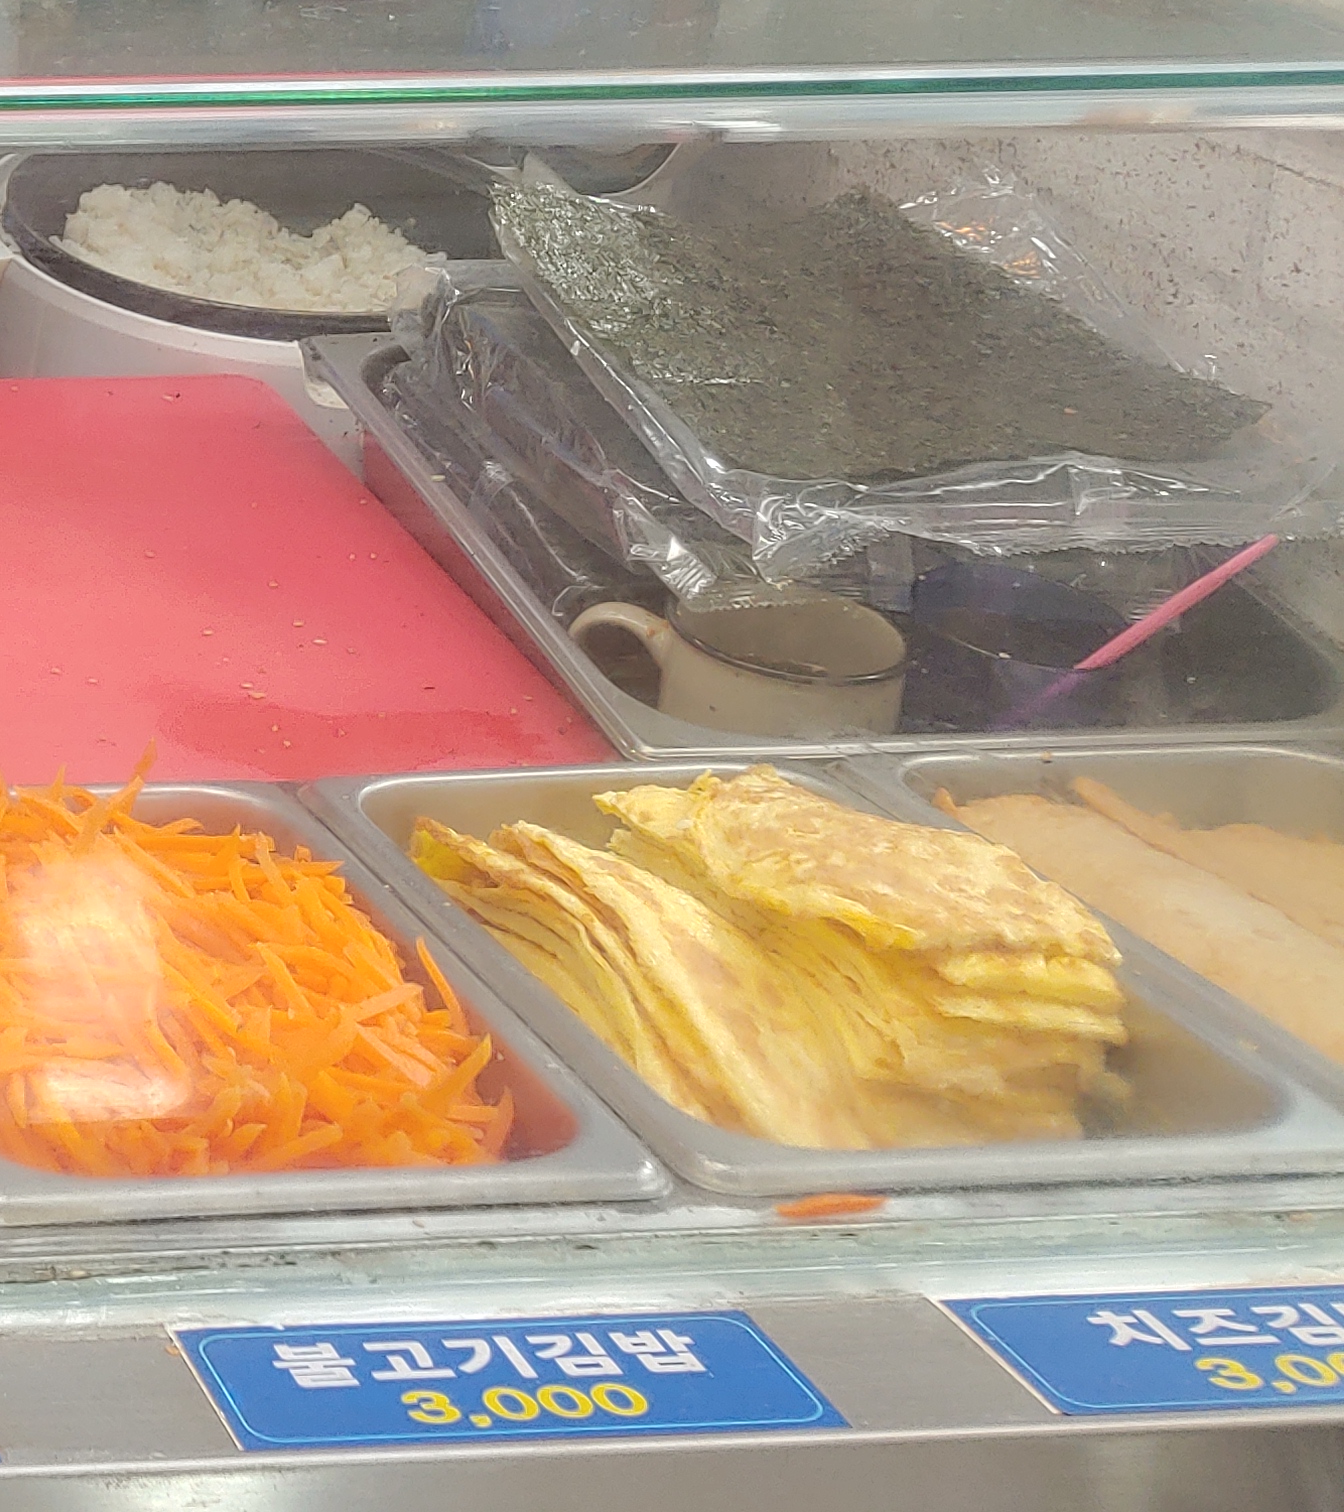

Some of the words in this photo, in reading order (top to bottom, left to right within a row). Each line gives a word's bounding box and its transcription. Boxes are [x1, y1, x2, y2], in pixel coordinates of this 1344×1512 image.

[1086, 1302, 1344, 1351] 치즈김
[272, 1329, 708, 1388] 불고기김밥
[1194, 1352, 1344, 1395] 3,0
[400, 1381, 650, 1428] 3,000
